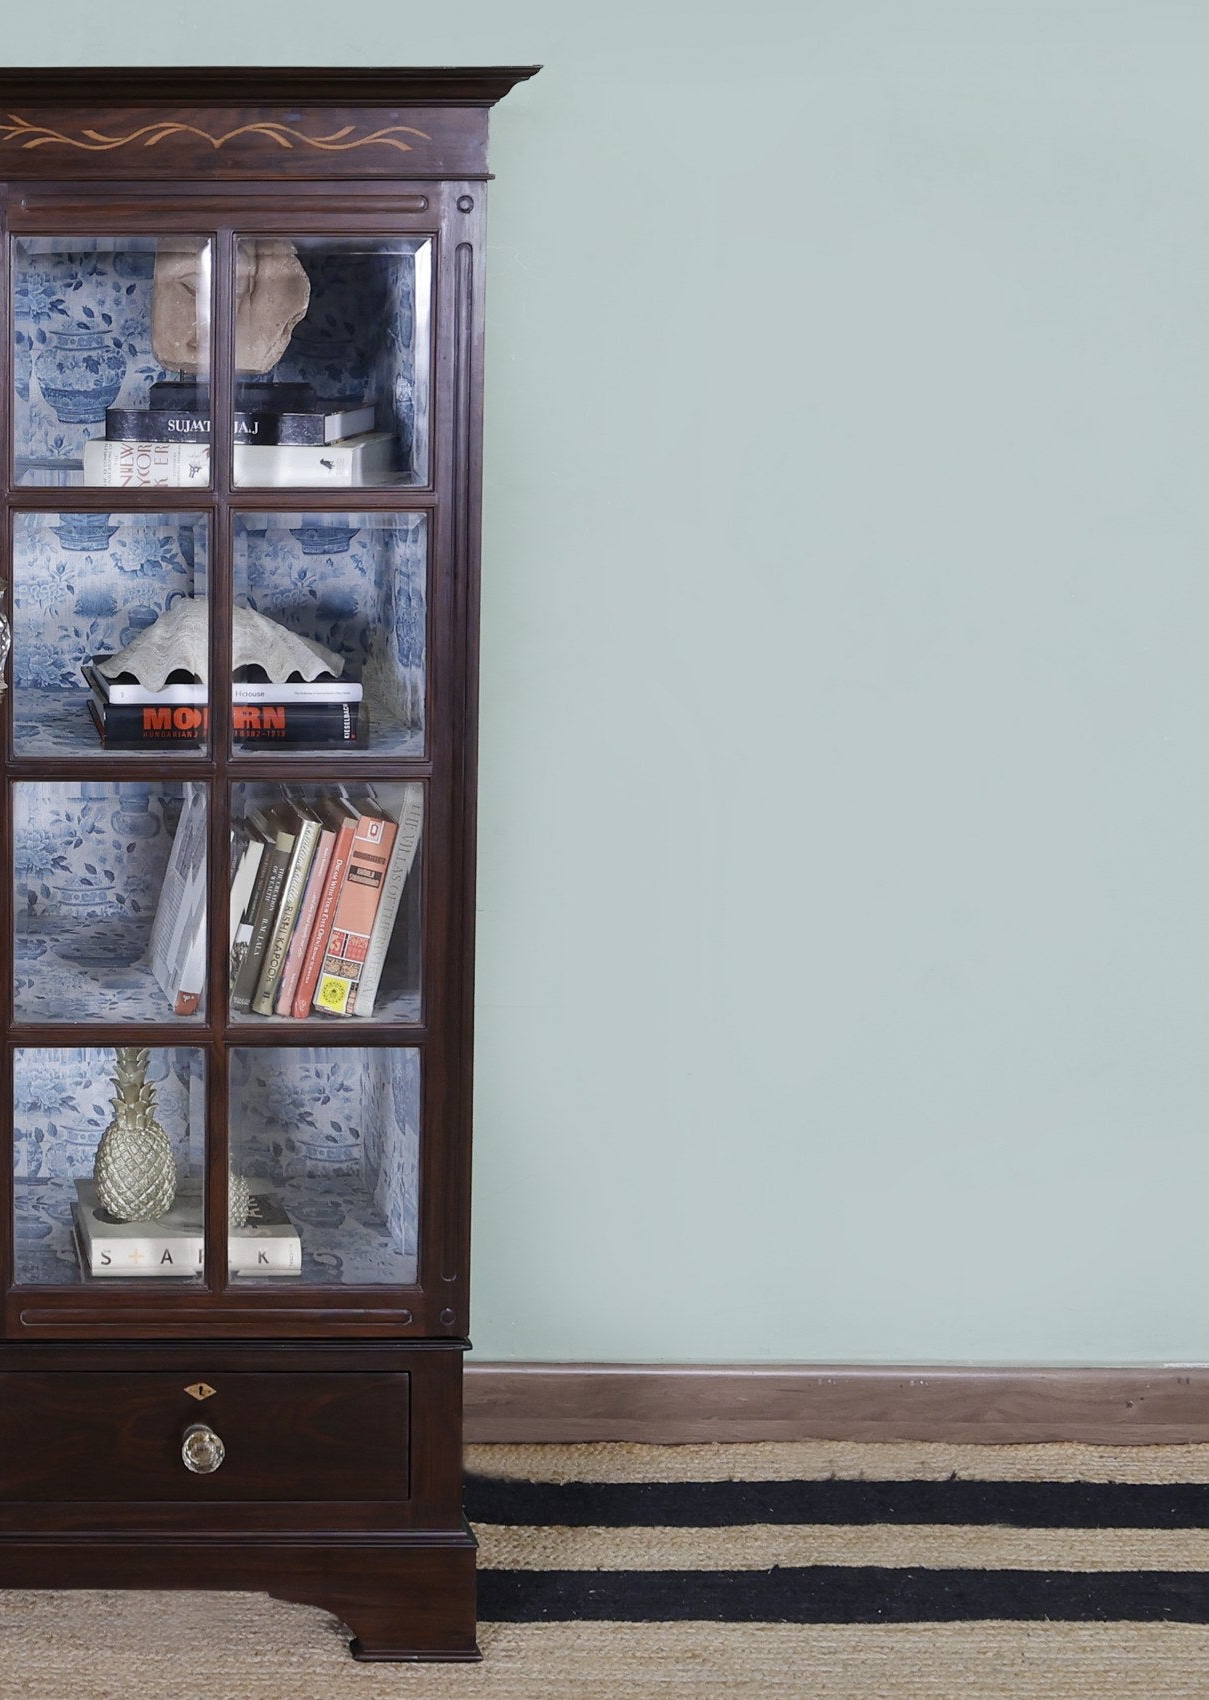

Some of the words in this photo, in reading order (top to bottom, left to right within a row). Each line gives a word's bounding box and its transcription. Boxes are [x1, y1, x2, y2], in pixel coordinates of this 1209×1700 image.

[167, 419, 211, 434] SUJAT
[330, 858, 343, 880] DREAM
[390, 832, 416, 884] VILLAS
[280, 905, 294, 935] RISHI
[253, 936, 264, 957] LALA
[266, 937, 284, 983] KAPOOR
